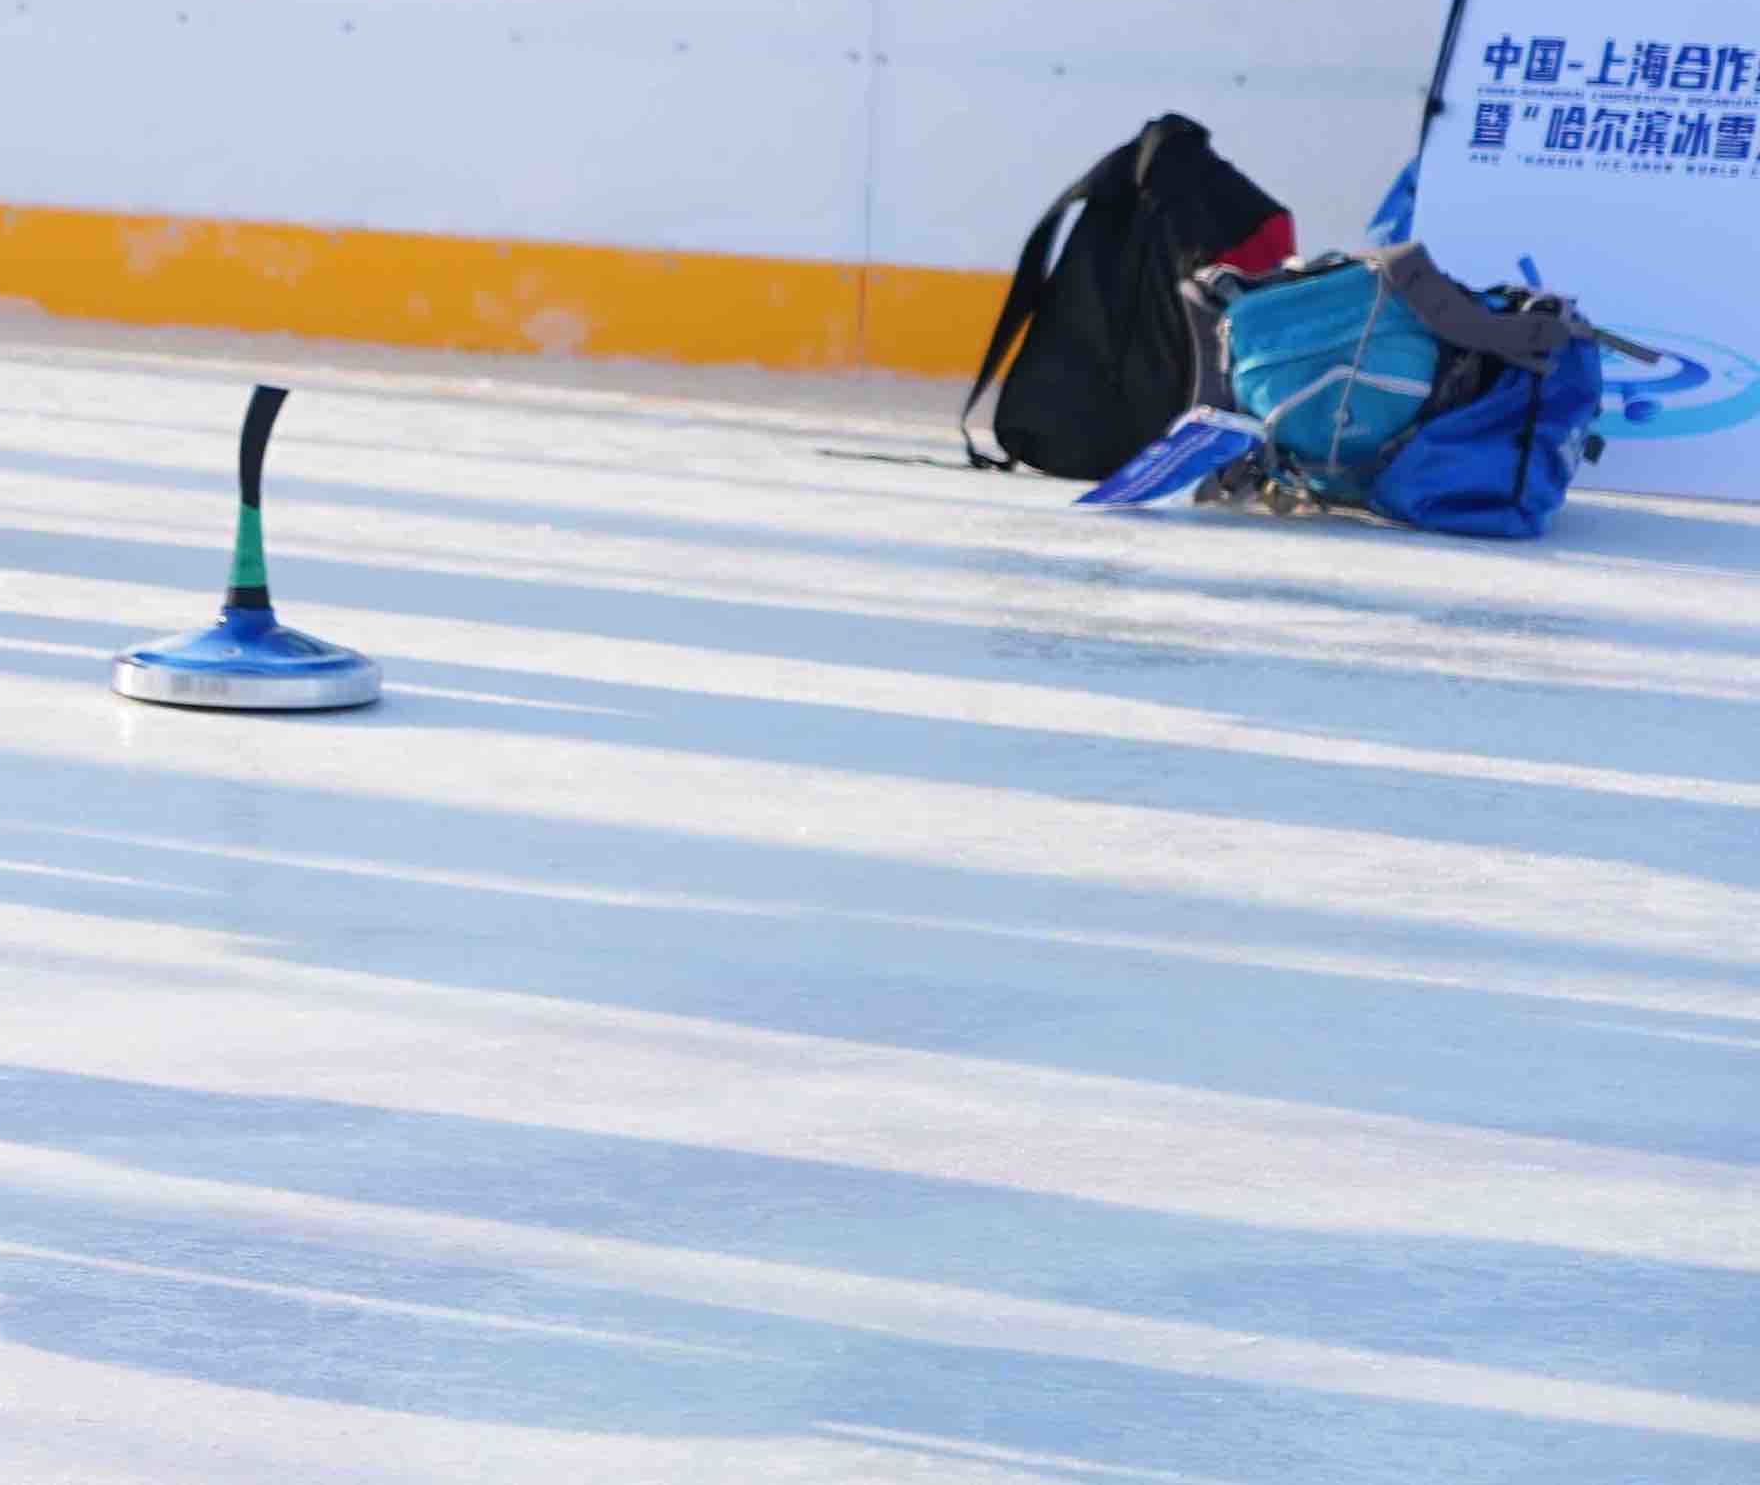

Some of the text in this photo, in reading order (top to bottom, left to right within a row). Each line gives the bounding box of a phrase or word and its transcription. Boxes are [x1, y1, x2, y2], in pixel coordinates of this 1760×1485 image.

[1483, 34, 1760, 94] 中国-上海合作
[1470, 101, 1760, 161] 暨“哈尔滨冰雪
